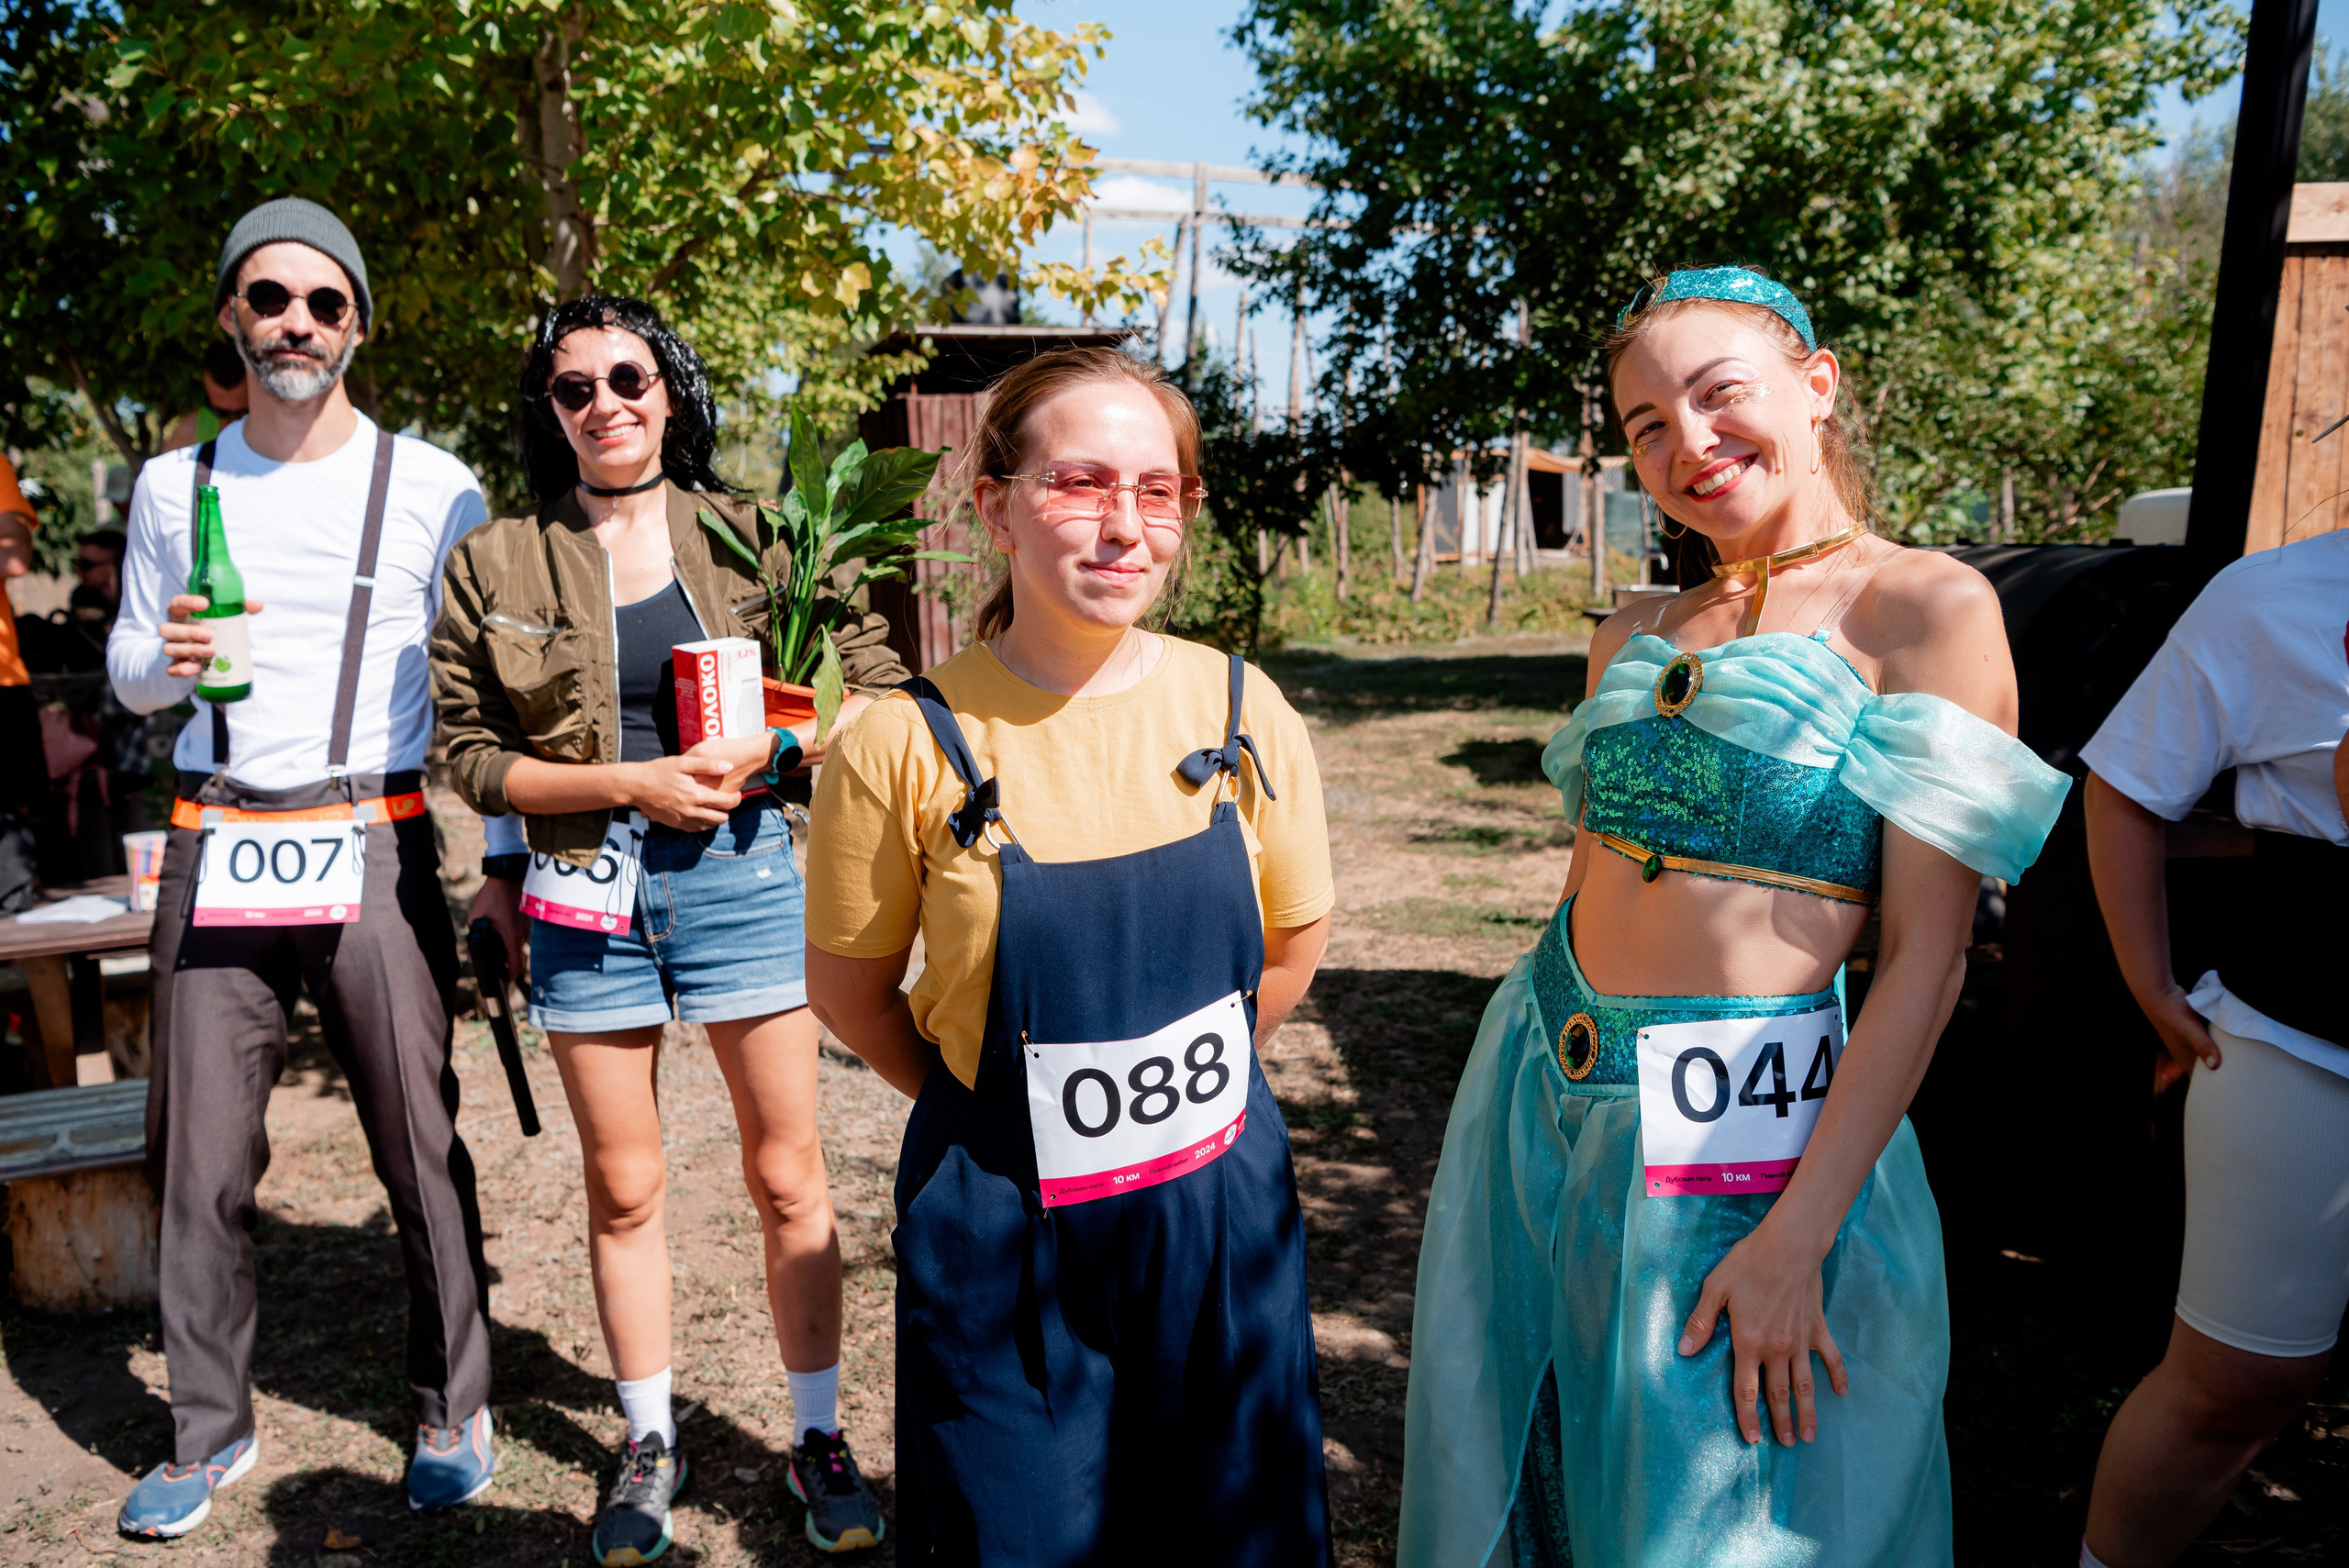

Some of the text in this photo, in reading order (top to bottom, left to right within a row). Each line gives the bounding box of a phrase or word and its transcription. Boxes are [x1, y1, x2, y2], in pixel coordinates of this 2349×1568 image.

[700, 654, 721, 741] ОЛОКО
[229, 839, 344, 884] 007
[1062, 1032, 1230, 1138] 088
[1671, 1035, 1834, 1123] 044
[1059, 1185, 1088, 1195] Дубовая
[1113, 1175, 1125, 1184] 10
[1126, 1173, 1141, 1182] км
[1149, 1163, 1173, 1174] Пивной
[1195, 1141, 1216, 1159] 2024
[1665, 1176, 1695, 1184] Дубовая
[1721, 1173, 1734, 1183] 10
